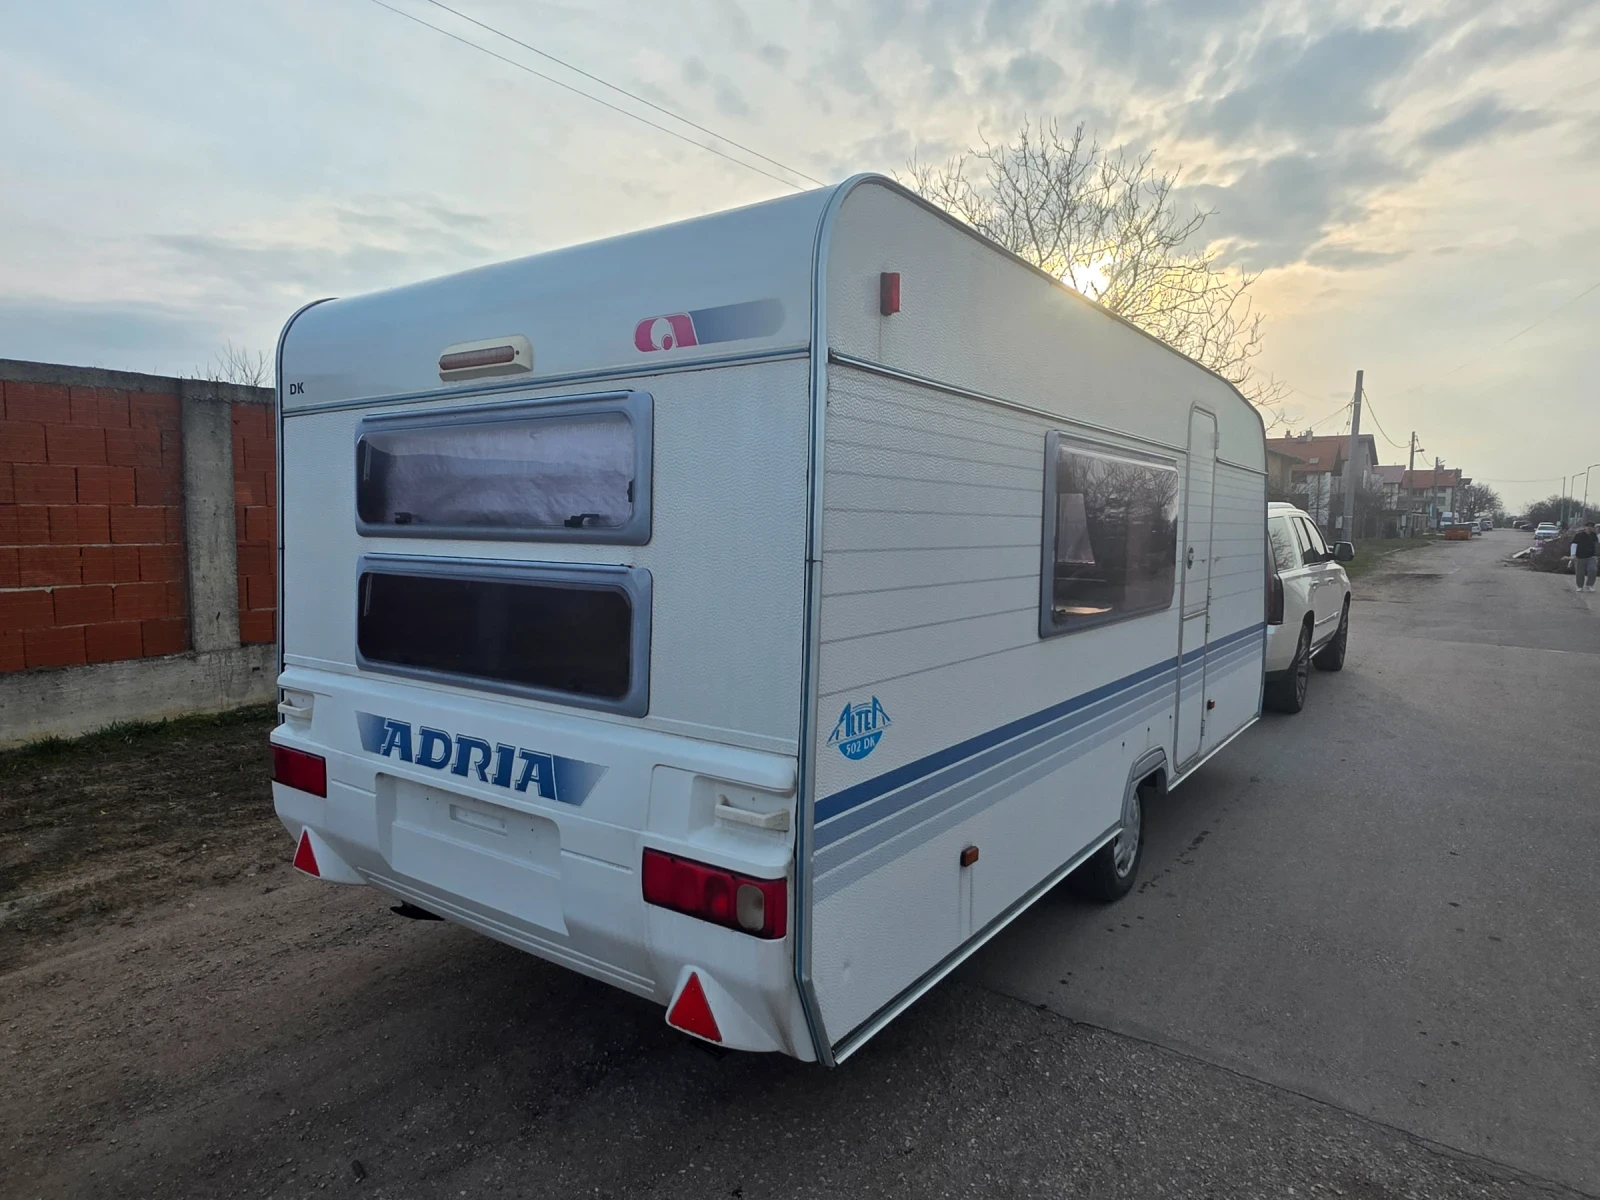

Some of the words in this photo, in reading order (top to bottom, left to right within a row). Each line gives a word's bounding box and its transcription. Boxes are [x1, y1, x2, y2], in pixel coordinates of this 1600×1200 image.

[289, 381, 305, 395] DK
[826, 695, 891, 743] ALTEA
[380, 717, 557, 801] ADRIA
[845, 739, 861, 756] 502
